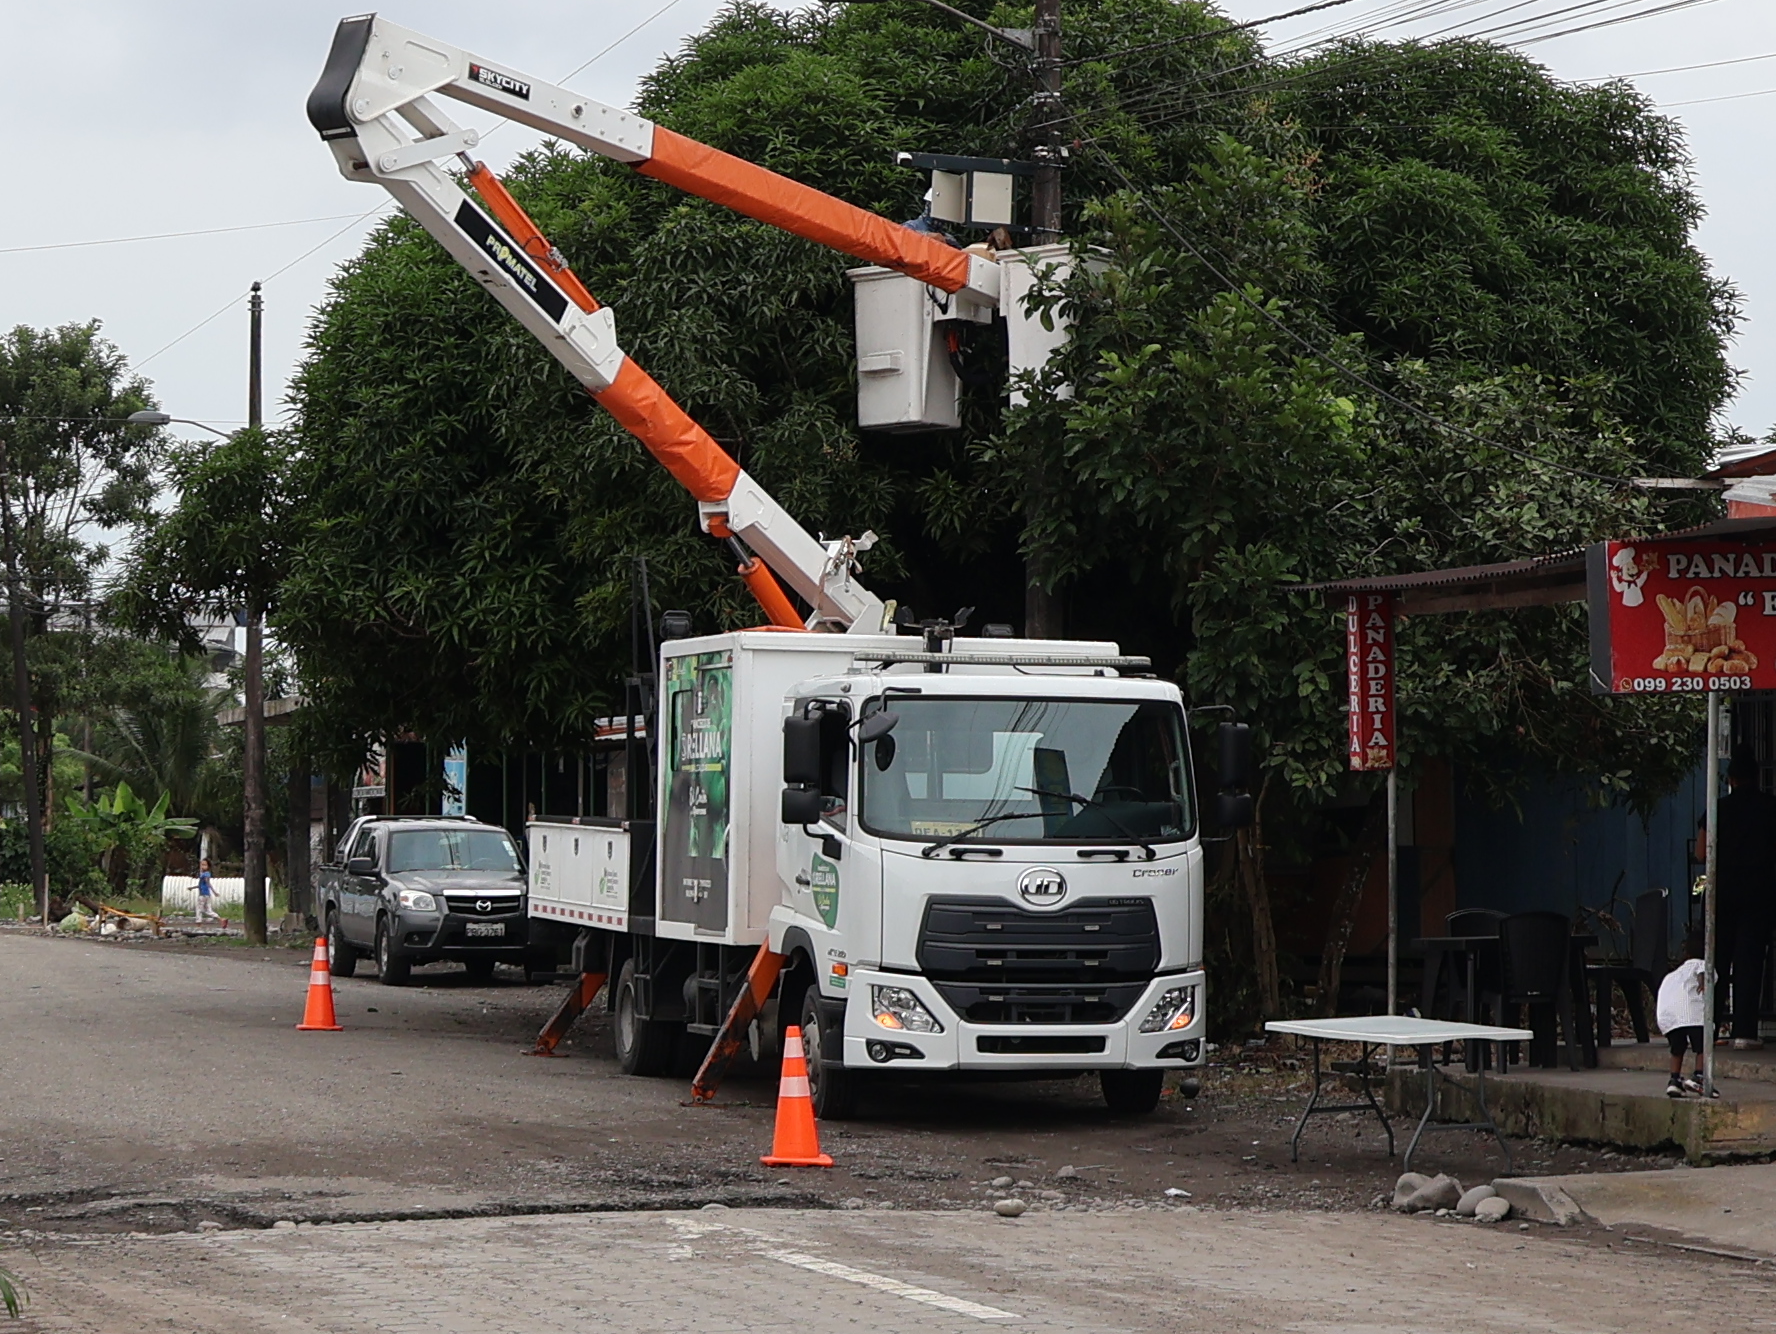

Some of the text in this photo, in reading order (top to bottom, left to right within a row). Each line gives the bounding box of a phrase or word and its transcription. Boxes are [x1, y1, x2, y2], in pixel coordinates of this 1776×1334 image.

[479, 68, 528, 94] SKYCITY
[486, 234, 538, 293] PROMATEL
[1349, 596, 1360, 752] DULCERIA
[1365, 595, 1388, 746] PANADERIA
[1633, 676, 1751, 691] 099 230 0503
[1023, 877, 1063, 895] UD
